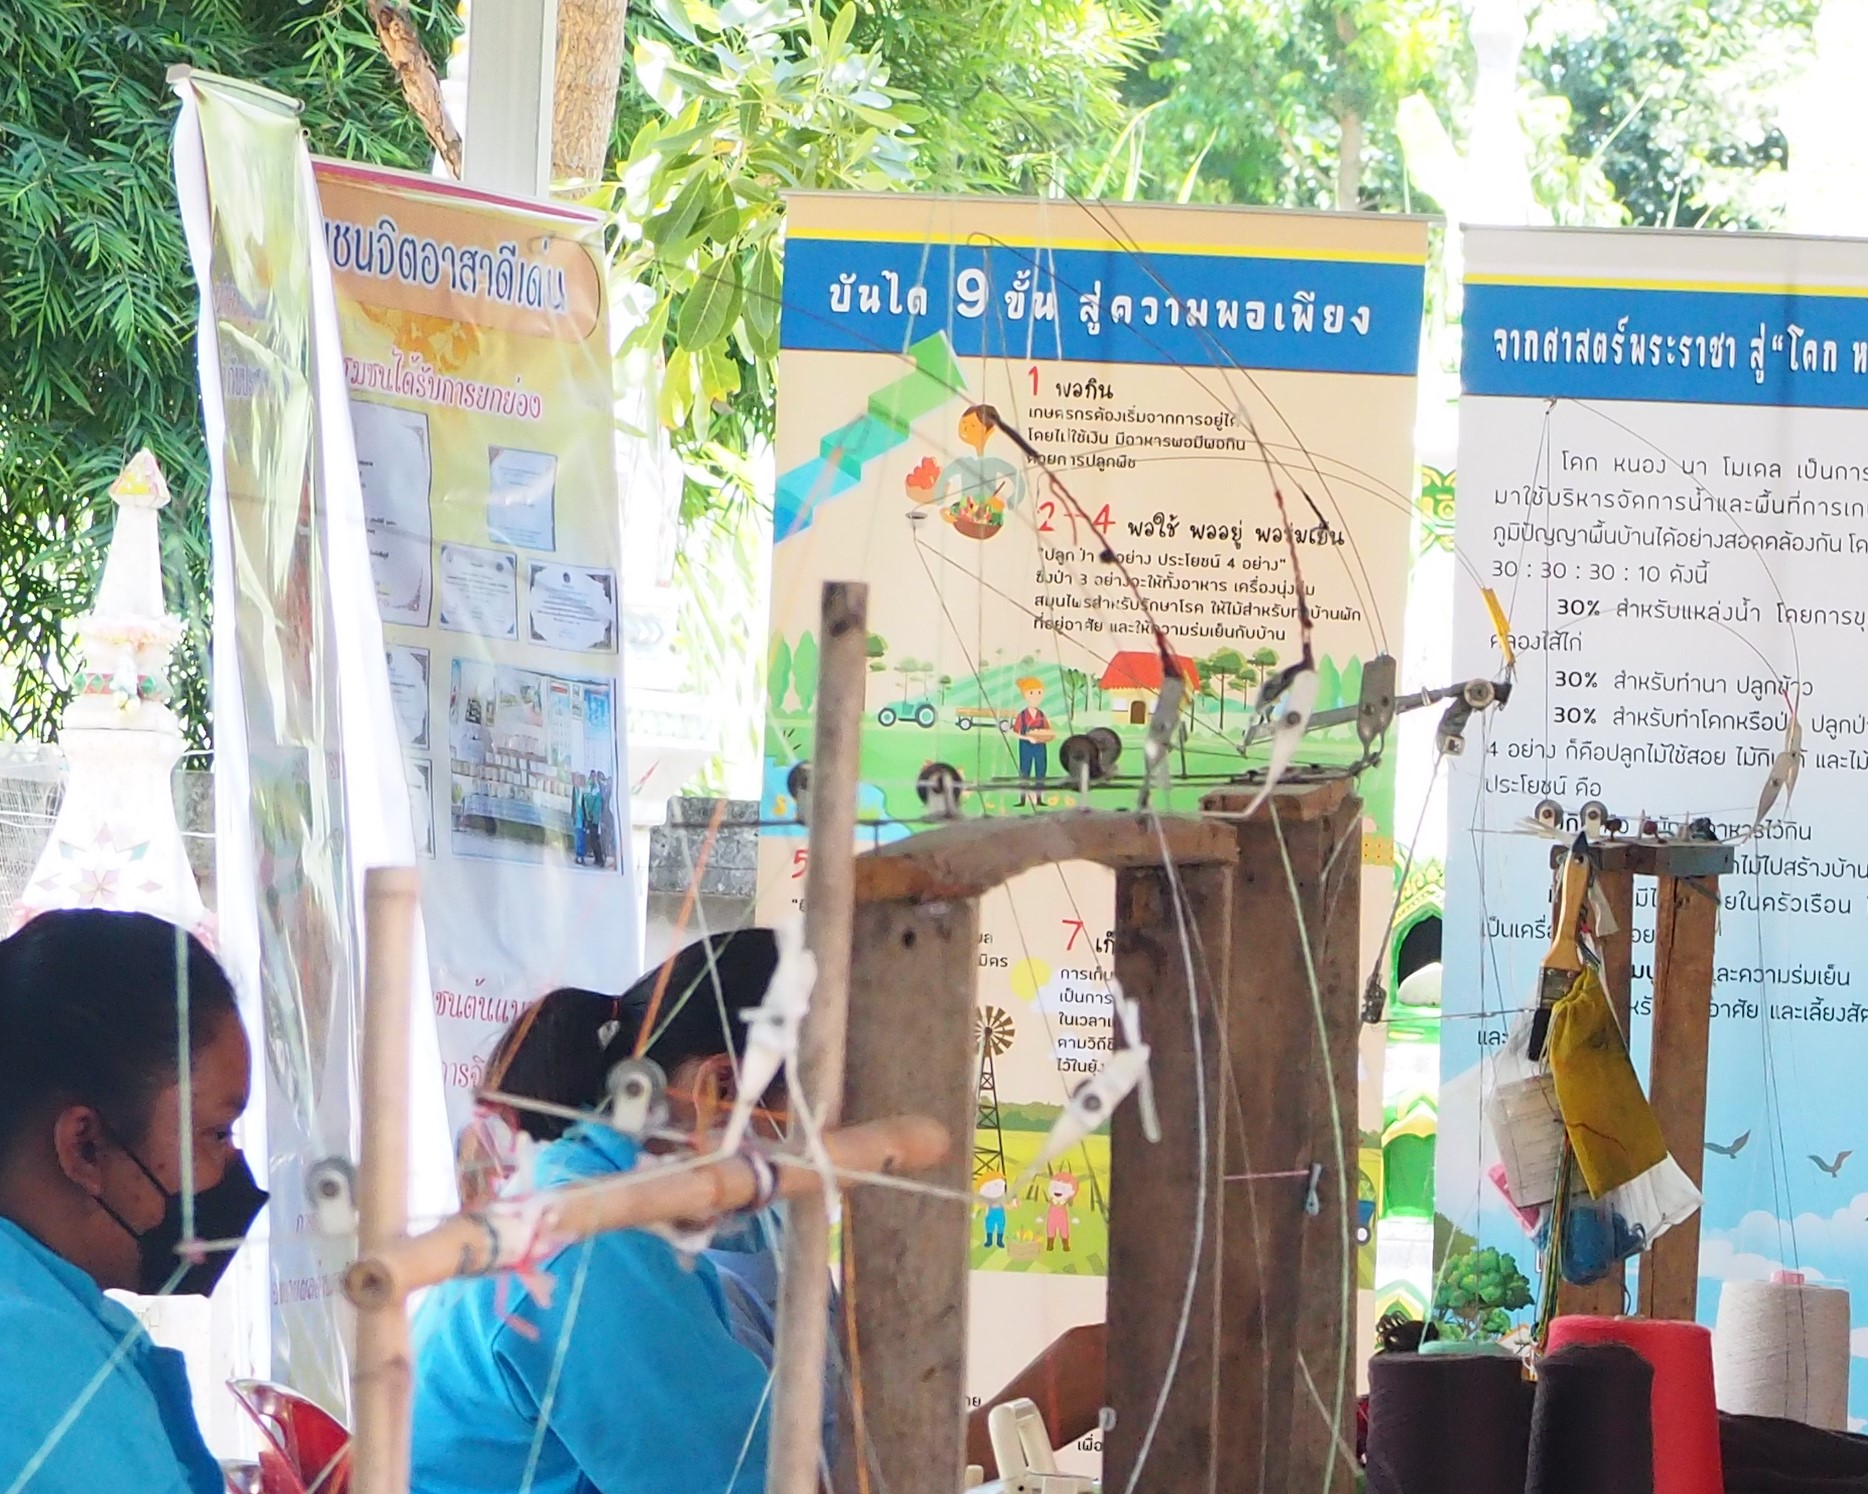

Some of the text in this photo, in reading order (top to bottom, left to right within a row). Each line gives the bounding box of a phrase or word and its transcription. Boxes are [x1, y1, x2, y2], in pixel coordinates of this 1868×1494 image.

[324, 219, 565, 311] ชนจิตอาสาดีเด่น
[829, 272, 928, 317] บันได
[956, 268, 988, 318] 9
[1004, 268, 1057, 321] ขั้น
[1494, 315, 1737, 371] จากศาสตร์พระราชา
[342, 349, 541, 419] มชนได้รับการยกย่อง
[1028, 365, 1039, 397] 1
[1562, 450, 1598, 473] โคก
[1613, 455, 1667, 475] หนอง
[1681, 458, 1708, 476] นา
[1723, 455, 1783, 479] โมเดล
[1128, 511, 1180, 538] พอใช้
[1190, 520, 1243, 550] พออยู่
[1226, 557, 1236, 569] 4
[1492, 560, 1519, 578] 30
[1540, 561, 1567, 580] 30
[1589, 563, 1616, 581] 30
[1638, 564, 1661, 583] 10
[1669, 559, 1711, 585] ดังนี้
[1556, 598, 1601, 617] 30%
[1615, 597, 1761, 623] สำหรับแหล่งน้ำ
[1554, 670, 1599, 690] 30%
[1613, 669, 1728, 694] สำหรับทำนา
[1553, 706, 1598, 726] 30%
[1612, 705, 1789, 733] สำหรับทำโคกหรือป่
[1507, 738, 1557, 760] อย่าง
[1566, 738, 1726, 770] ก็คือปลูกไม้ใช้สอย
[1576, 776, 1602, 797] คือ
[1724, 890, 1851, 915] ยในครัวเรือน
[1062, 919, 1084, 951] 7
[1713, 963, 1851, 986] ละความร่มเย็น
